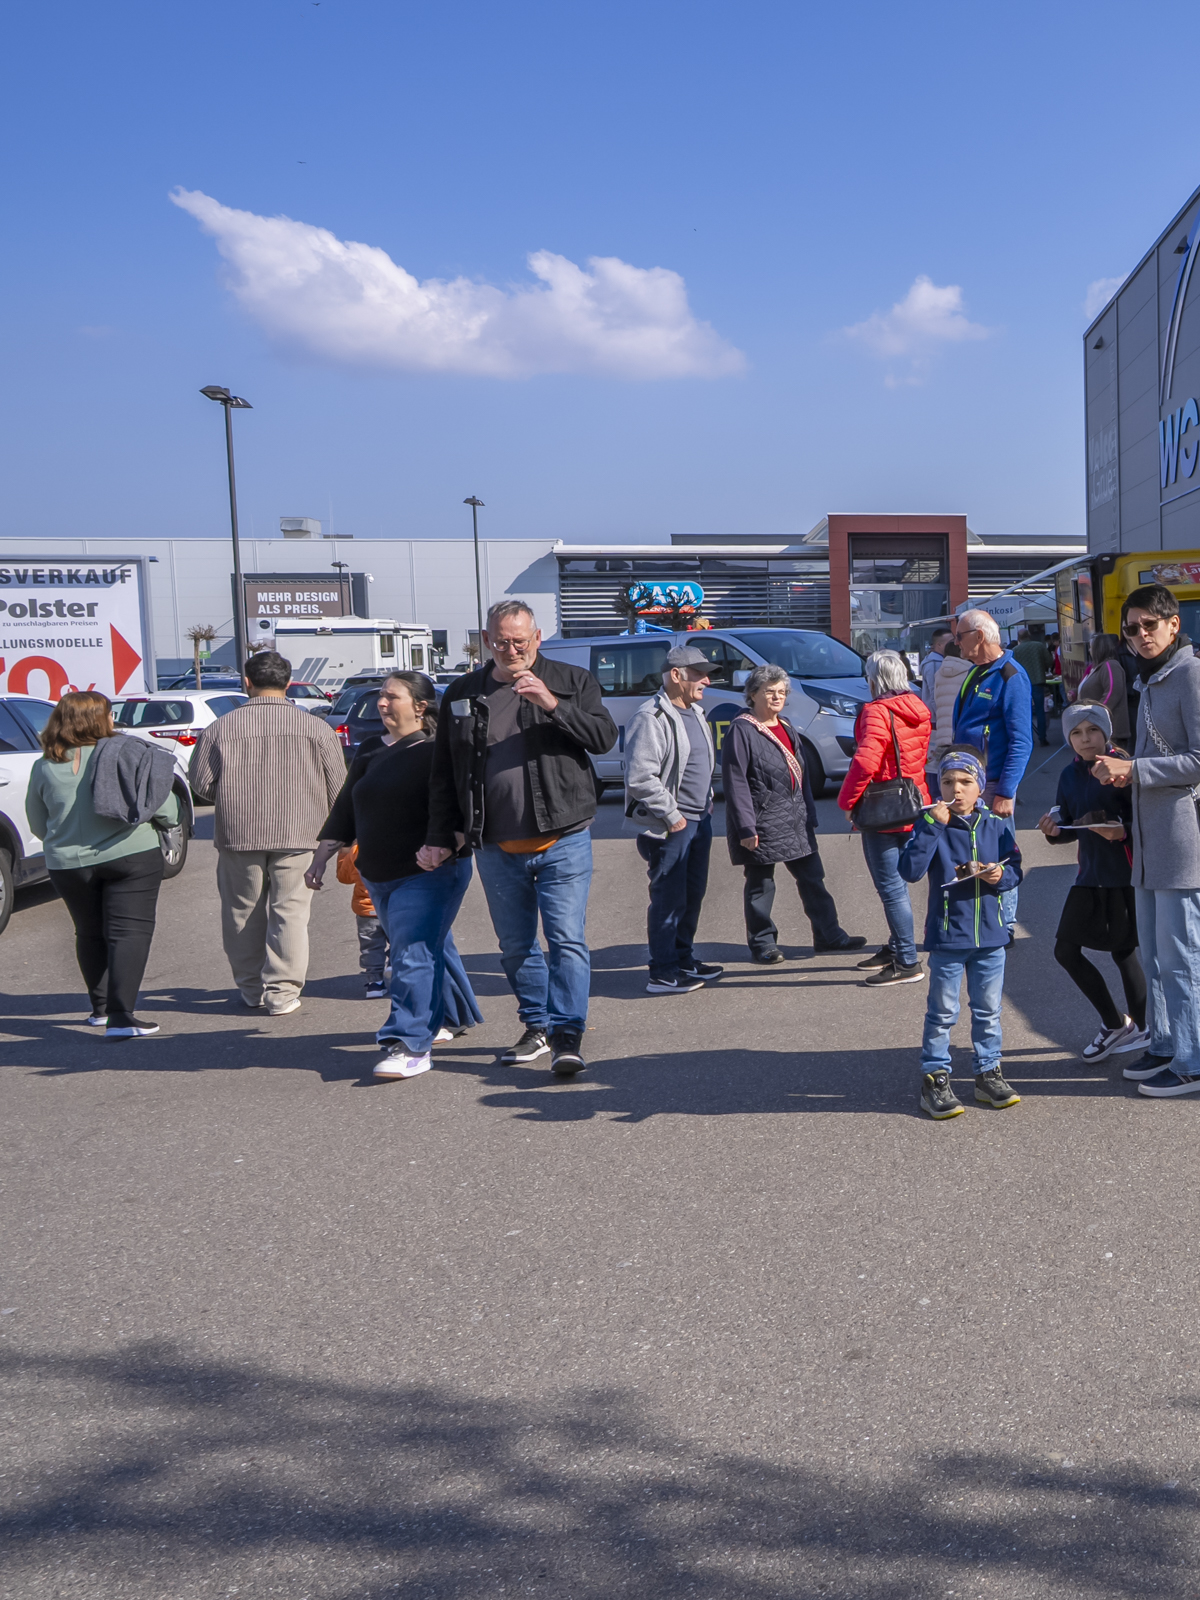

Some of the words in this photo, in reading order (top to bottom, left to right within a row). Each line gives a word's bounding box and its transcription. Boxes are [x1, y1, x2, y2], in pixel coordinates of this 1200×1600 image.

[0, 568, 132, 585] SVERKAUF
[257, 592, 292, 602] MEHR
[295, 592, 339, 602] DESIGN
[258, 604, 281, 614] ALS
[284, 604, 323, 614] PREIS.
[13, 620, 69, 628] unschlagbaren
[0, 638, 104, 649] LUNGSMODELLE
